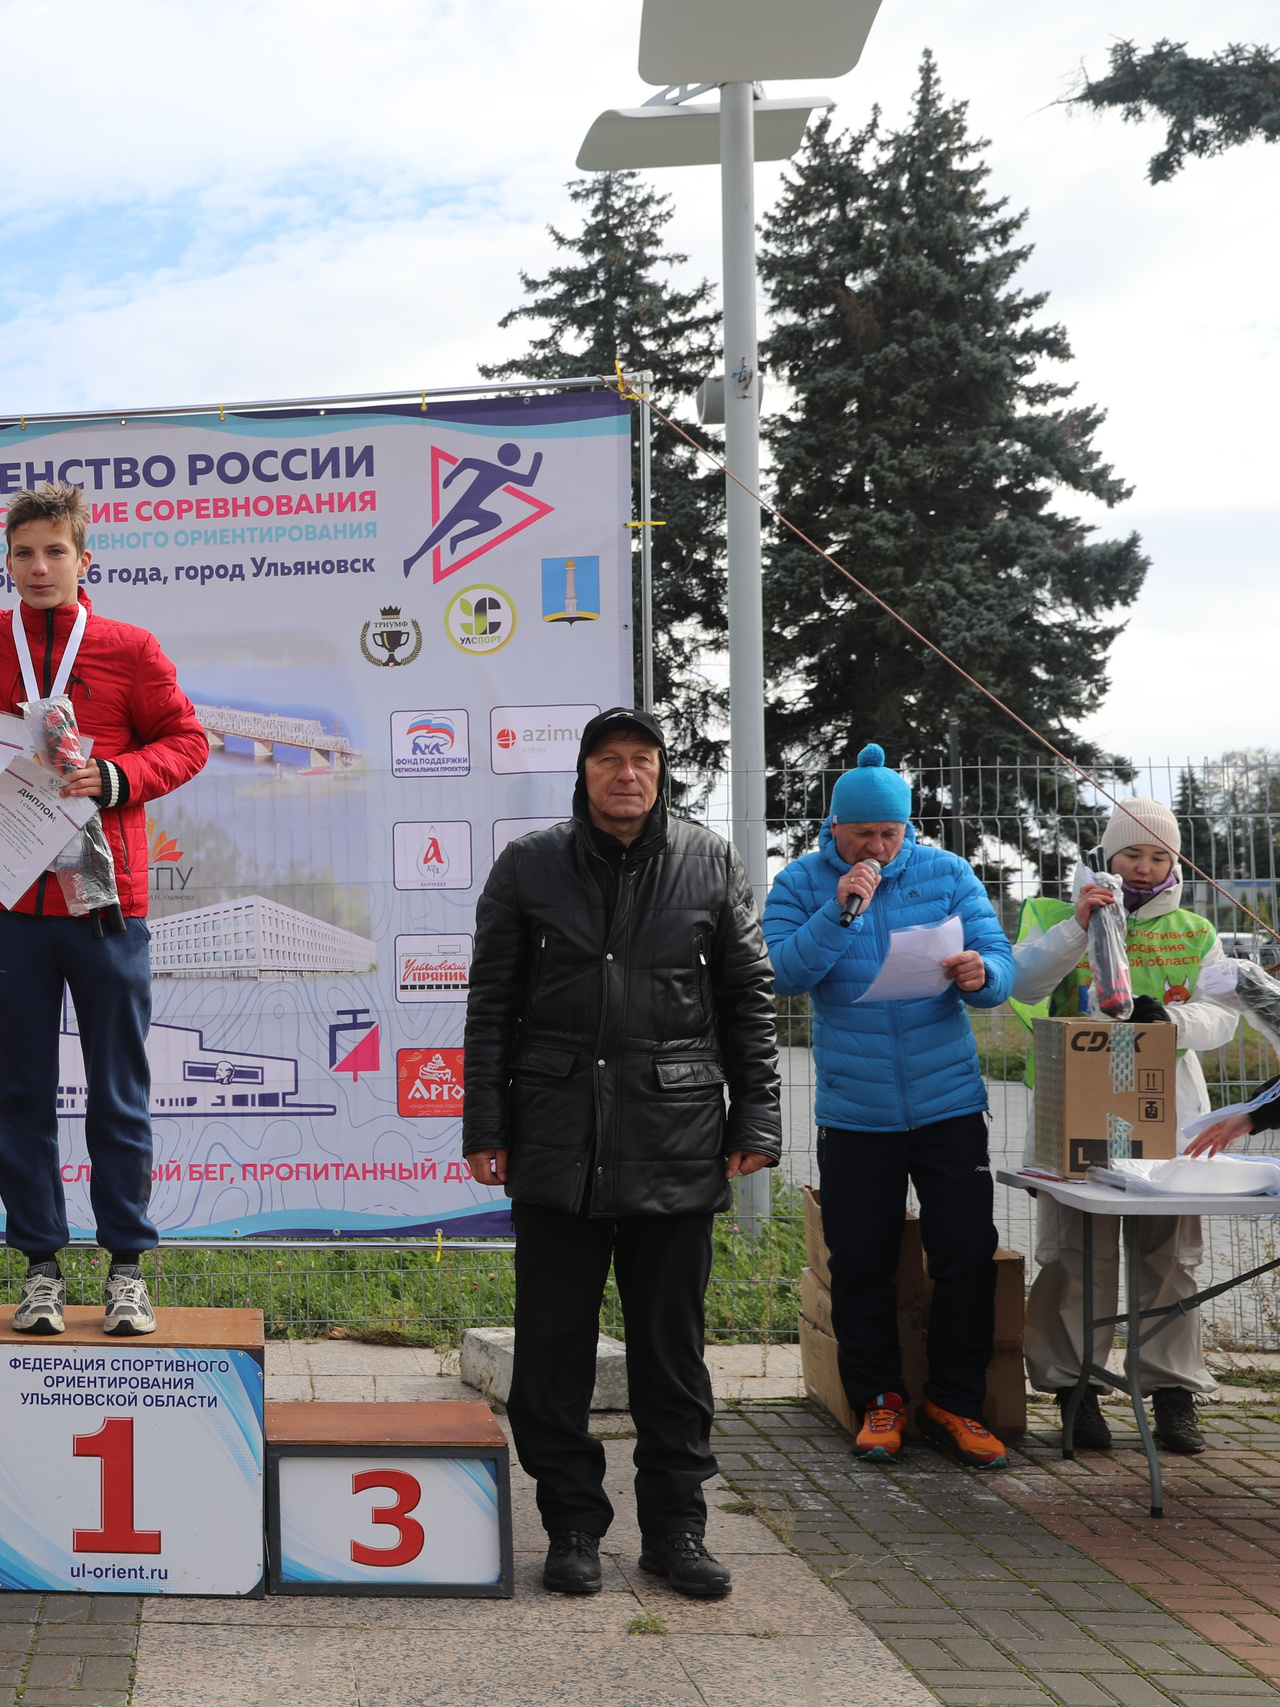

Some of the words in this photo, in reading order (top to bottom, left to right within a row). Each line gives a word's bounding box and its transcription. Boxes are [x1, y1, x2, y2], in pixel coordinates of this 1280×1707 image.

[188, 445, 374, 486] РОССИИ
[135, 490, 377, 522] СОРЕВНОВАНИЯ
[173, 521, 378, 547] ОРИЕНТИРОВАНИЯ
[108, 566, 169, 586] года,
[175, 563, 245, 586] город
[250, 556, 375, 578] Ульяновск
[373, 621, 409, 629] ТРИУМФ
[459, 635, 502, 645] УЛСПОРТ
[395, 758, 418, 766] ФОНД
[419, 757, 468, 766] ПОДДЕРЖКИ
[18, 787, 57, 823] ДИПЛОМ
[402, 958, 467, 983] Ульяновский
[412, 971, 468, 982] ПРЯНИК
[407, 1078, 465, 1100] АРГО
[1147, 1107, 1156, 1115] 12
[1077, 1147, 1091, 1165] L
[188, 1163, 235, 1184] БЕГ,
[241, 1158, 437, 1181] ПРОПИТАННЫЙ
[9, 1357, 106, 1372] ФЕДЕРАЦИЯ
[110, 1359, 230, 1373] СПОРТИВНОГО
[43, 1375, 194, 1390] ОРИЕНТИРОВАНИЯ
[21, 1391, 139, 1407] УЛЬЯНОВСКОЙ
[142, 1394, 218, 1408] ОБЛАСТИ
[73, 1416, 161, 1555] 1
[350, 1468, 425, 1567] 3
[70, 1564, 169, 1580] ul-orient.ru
